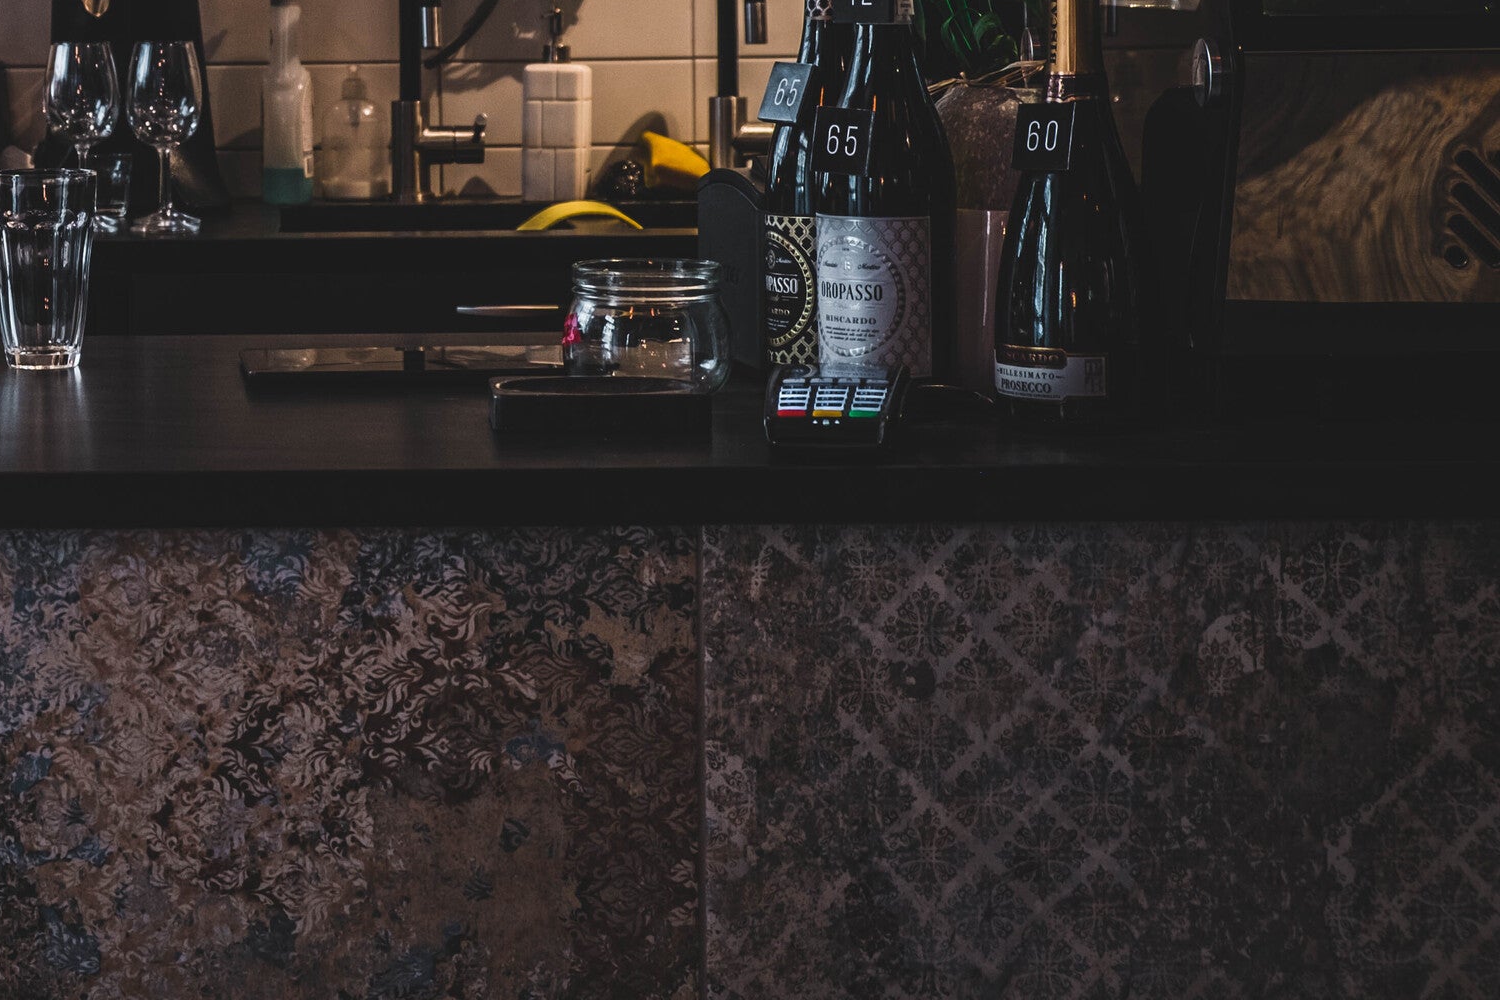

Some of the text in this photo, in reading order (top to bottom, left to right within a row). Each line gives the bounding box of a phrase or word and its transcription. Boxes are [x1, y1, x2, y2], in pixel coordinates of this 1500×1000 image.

[773, 78, 801, 107] 65
[826, 124, 859, 156] 65
[1026, 120, 1059, 151] 60
[821, 281, 883, 301] OROPASSO
[825, 314, 877, 325] BISCARDO
[1001, 378, 1052, 393] PROSECCO
